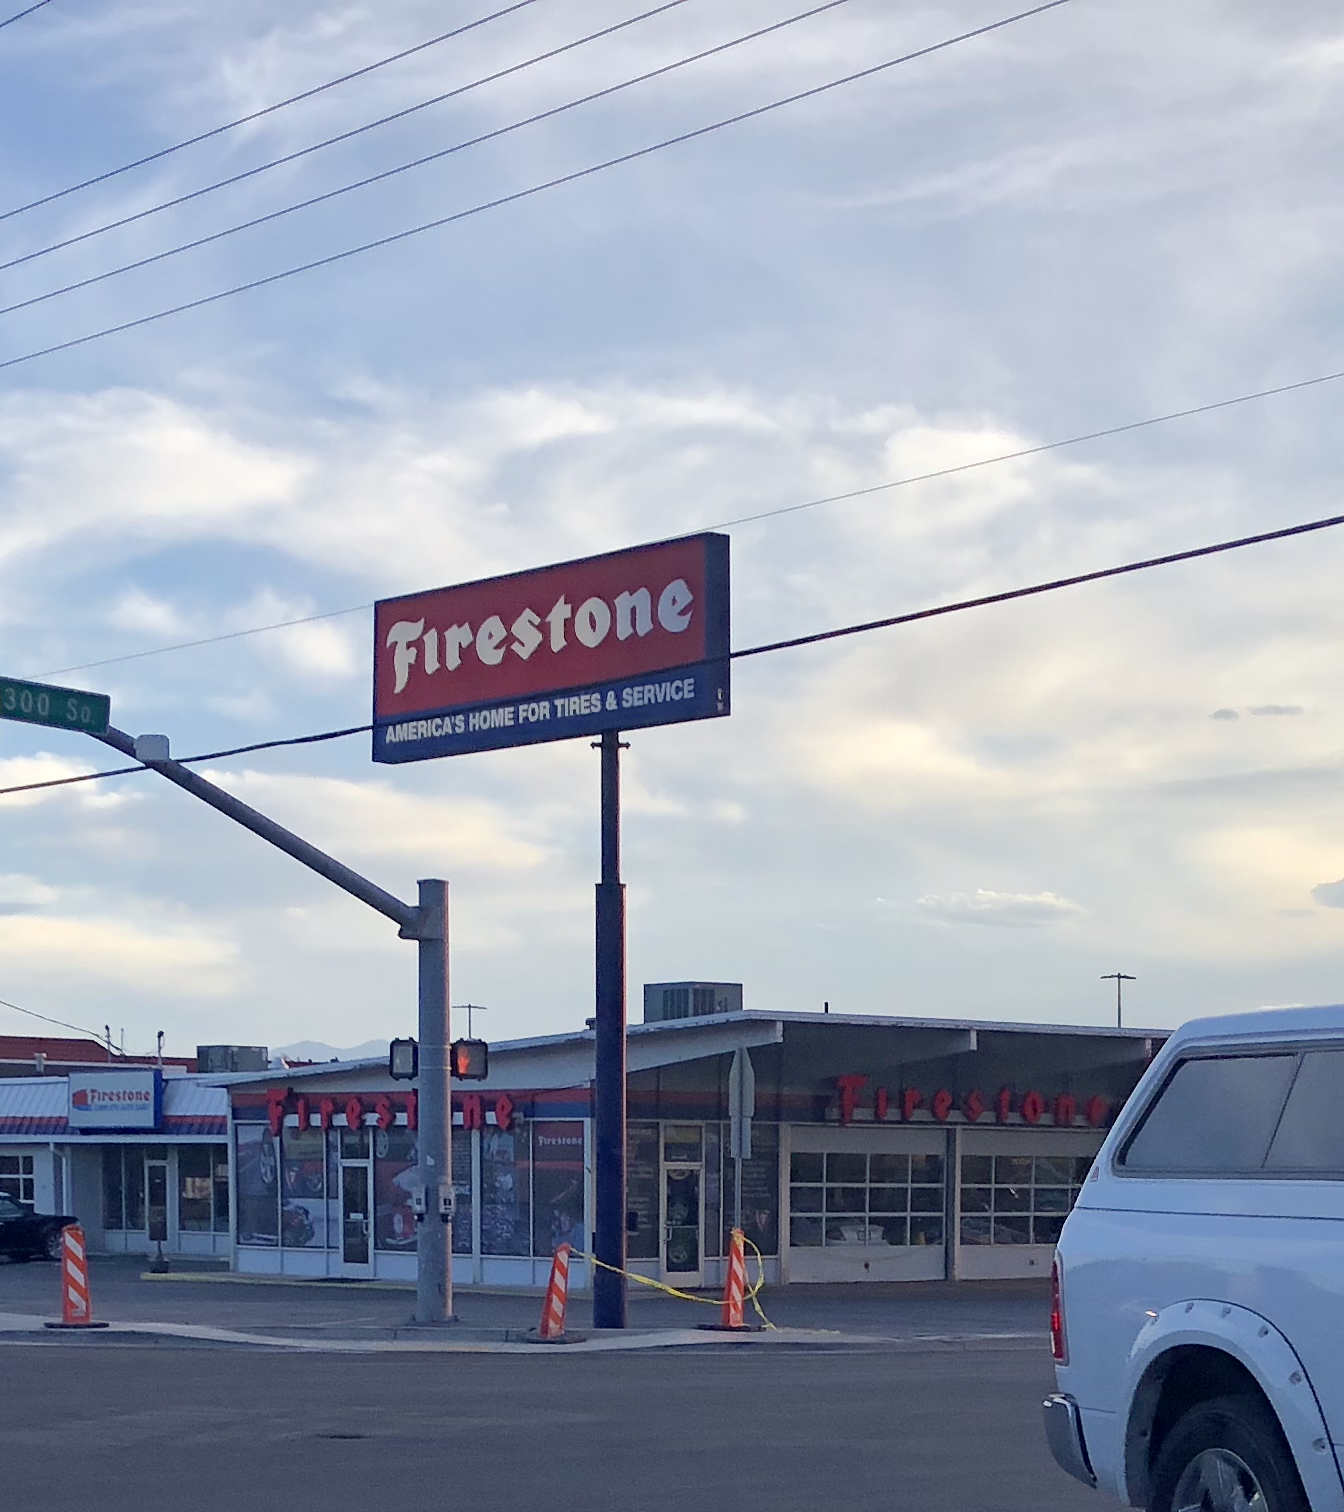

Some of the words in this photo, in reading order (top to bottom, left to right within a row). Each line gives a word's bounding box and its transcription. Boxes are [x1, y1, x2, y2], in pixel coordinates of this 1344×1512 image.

[386, 578, 694, 695] Firestone
[4, 687, 50, 716] 300
[385, 712, 465, 744] AMERICA'S
[468, 706, 515, 732] HOME
[518, 701, 550, 725] FOR
[553, 693, 601, 719] TIRES
[606, 689, 618, 711] &
[622, 678, 695, 709] SERVICE
[90, 1088, 151, 1104] Firestone
[266, 1088, 514, 1137] Firestne
[538, 1135, 583, 1147] Firestone
